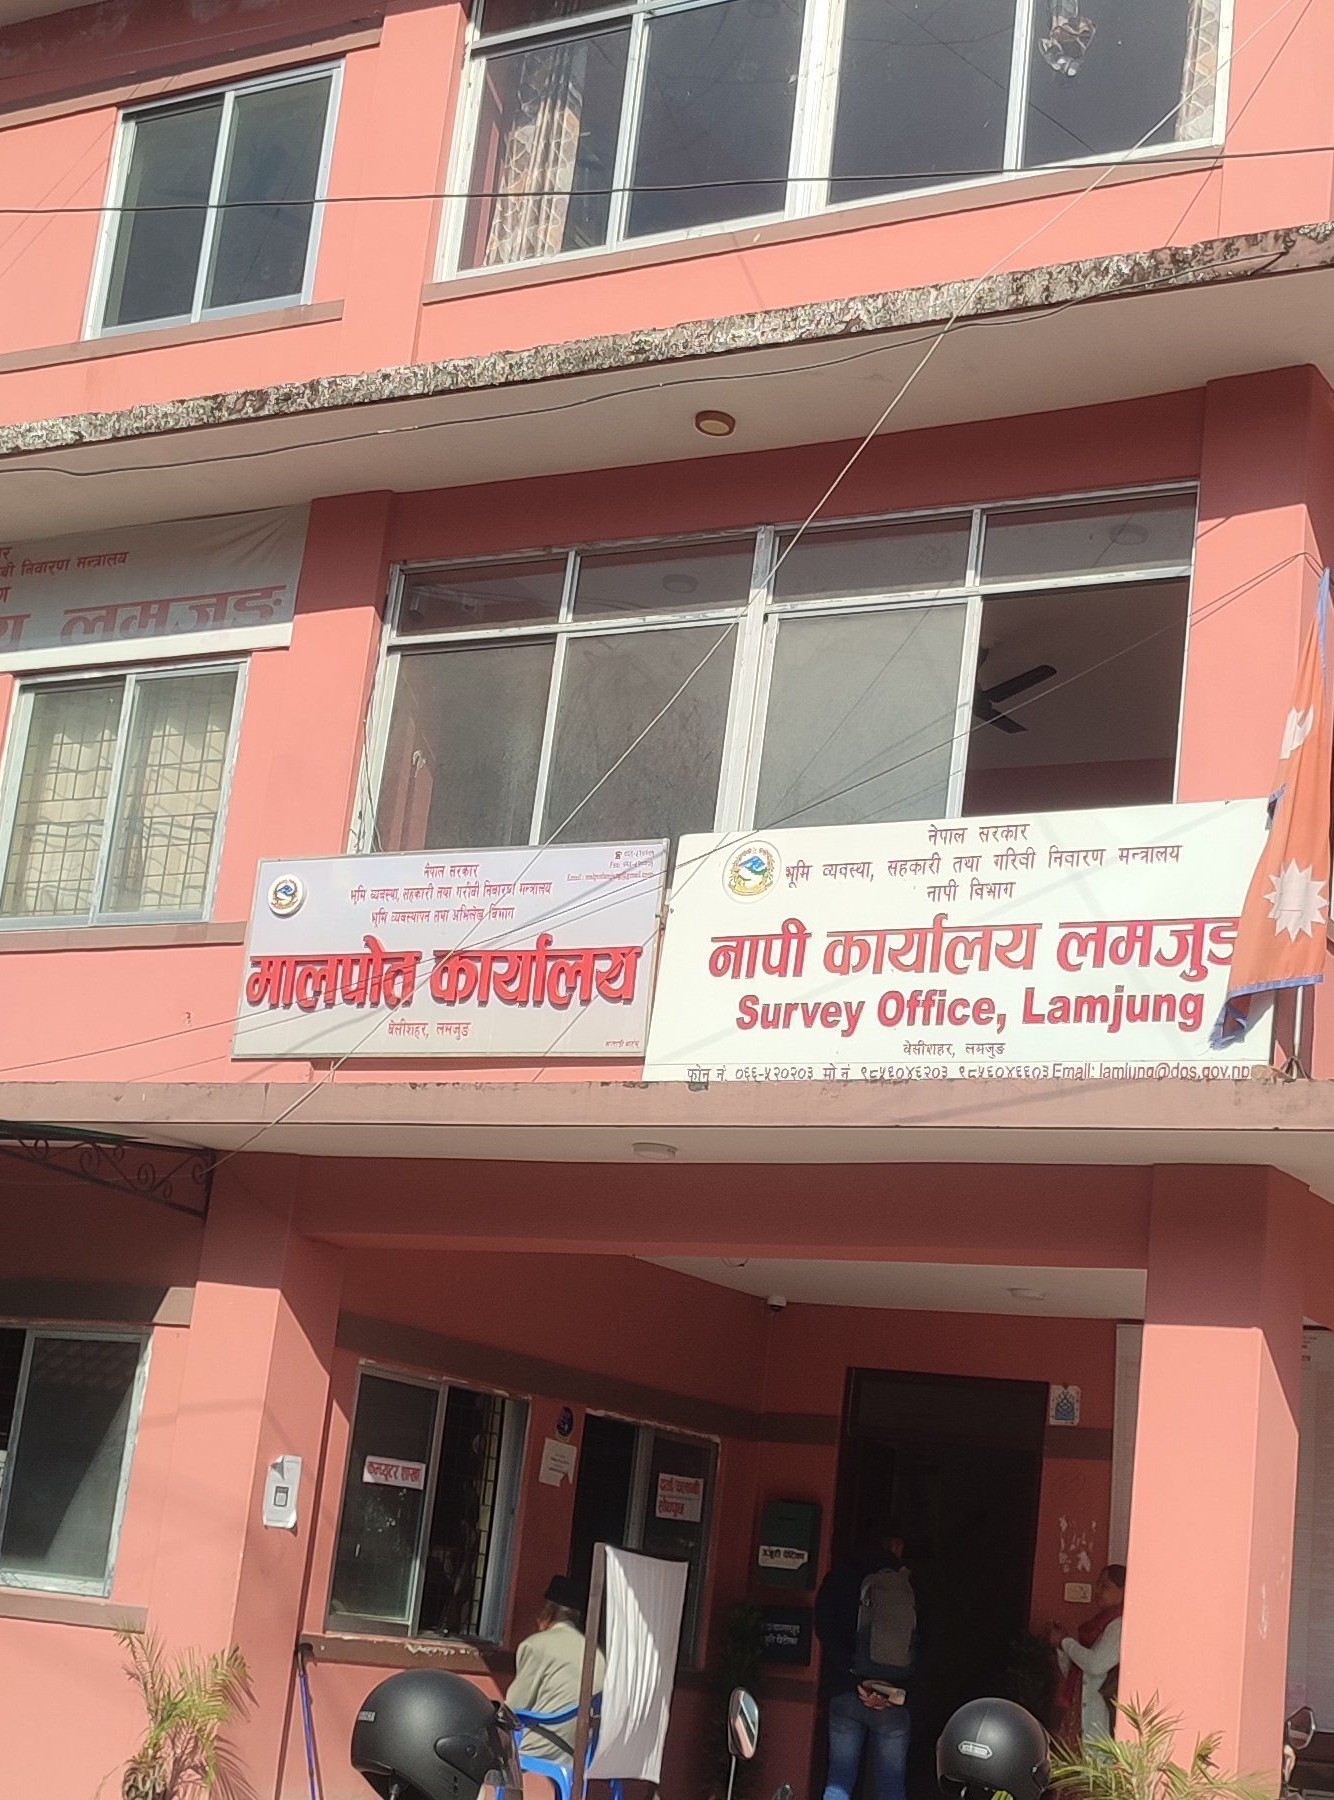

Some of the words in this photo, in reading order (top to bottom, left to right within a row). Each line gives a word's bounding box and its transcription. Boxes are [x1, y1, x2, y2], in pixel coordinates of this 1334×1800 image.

[21, 559, 70, 578] निवारण
[76, 551, 130, 569] मन्त्रालय
[928, 824, 968, 846] नेपाल
[979, 823, 1031, 843] सरकार
[423, 862, 446, 878] नेपाल
[450, 864, 479, 878] सरकार
[785, 860, 812, 888] भूमि
[822, 861, 875, 882] व्यवस्था,
[887, 851, 942, 877] सहकारी
[953, 855, 983, 873] तथा
[1048, 844, 1107, 869] निवारण
[1118, 844, 1183, 866] मन्त्रालय
[402, 883, 434, 902] सहकारी
[436, 886, 453, 900] तथा
[926, 879, 959, 903] नापी
[969, 878, 1017, 901] विभाग
[434, 909, 449, 923] तथा
[708, 917, 813, 980] नापी
[823, 912, 1043, 977] कार्यालय
[246, 934, 422, 1011] मालपोत
[430, 932, 644, 1009] कार्यालय
[735, 994, 866, 1038] Survey
[877, 988, 1007, 1034] Office,
[1021, 984, 1206, 1034] Lamjung
[436, 1022, 472, 1040] लमजुङ
[965, 1042, 1007, 1060] लमजुङ
